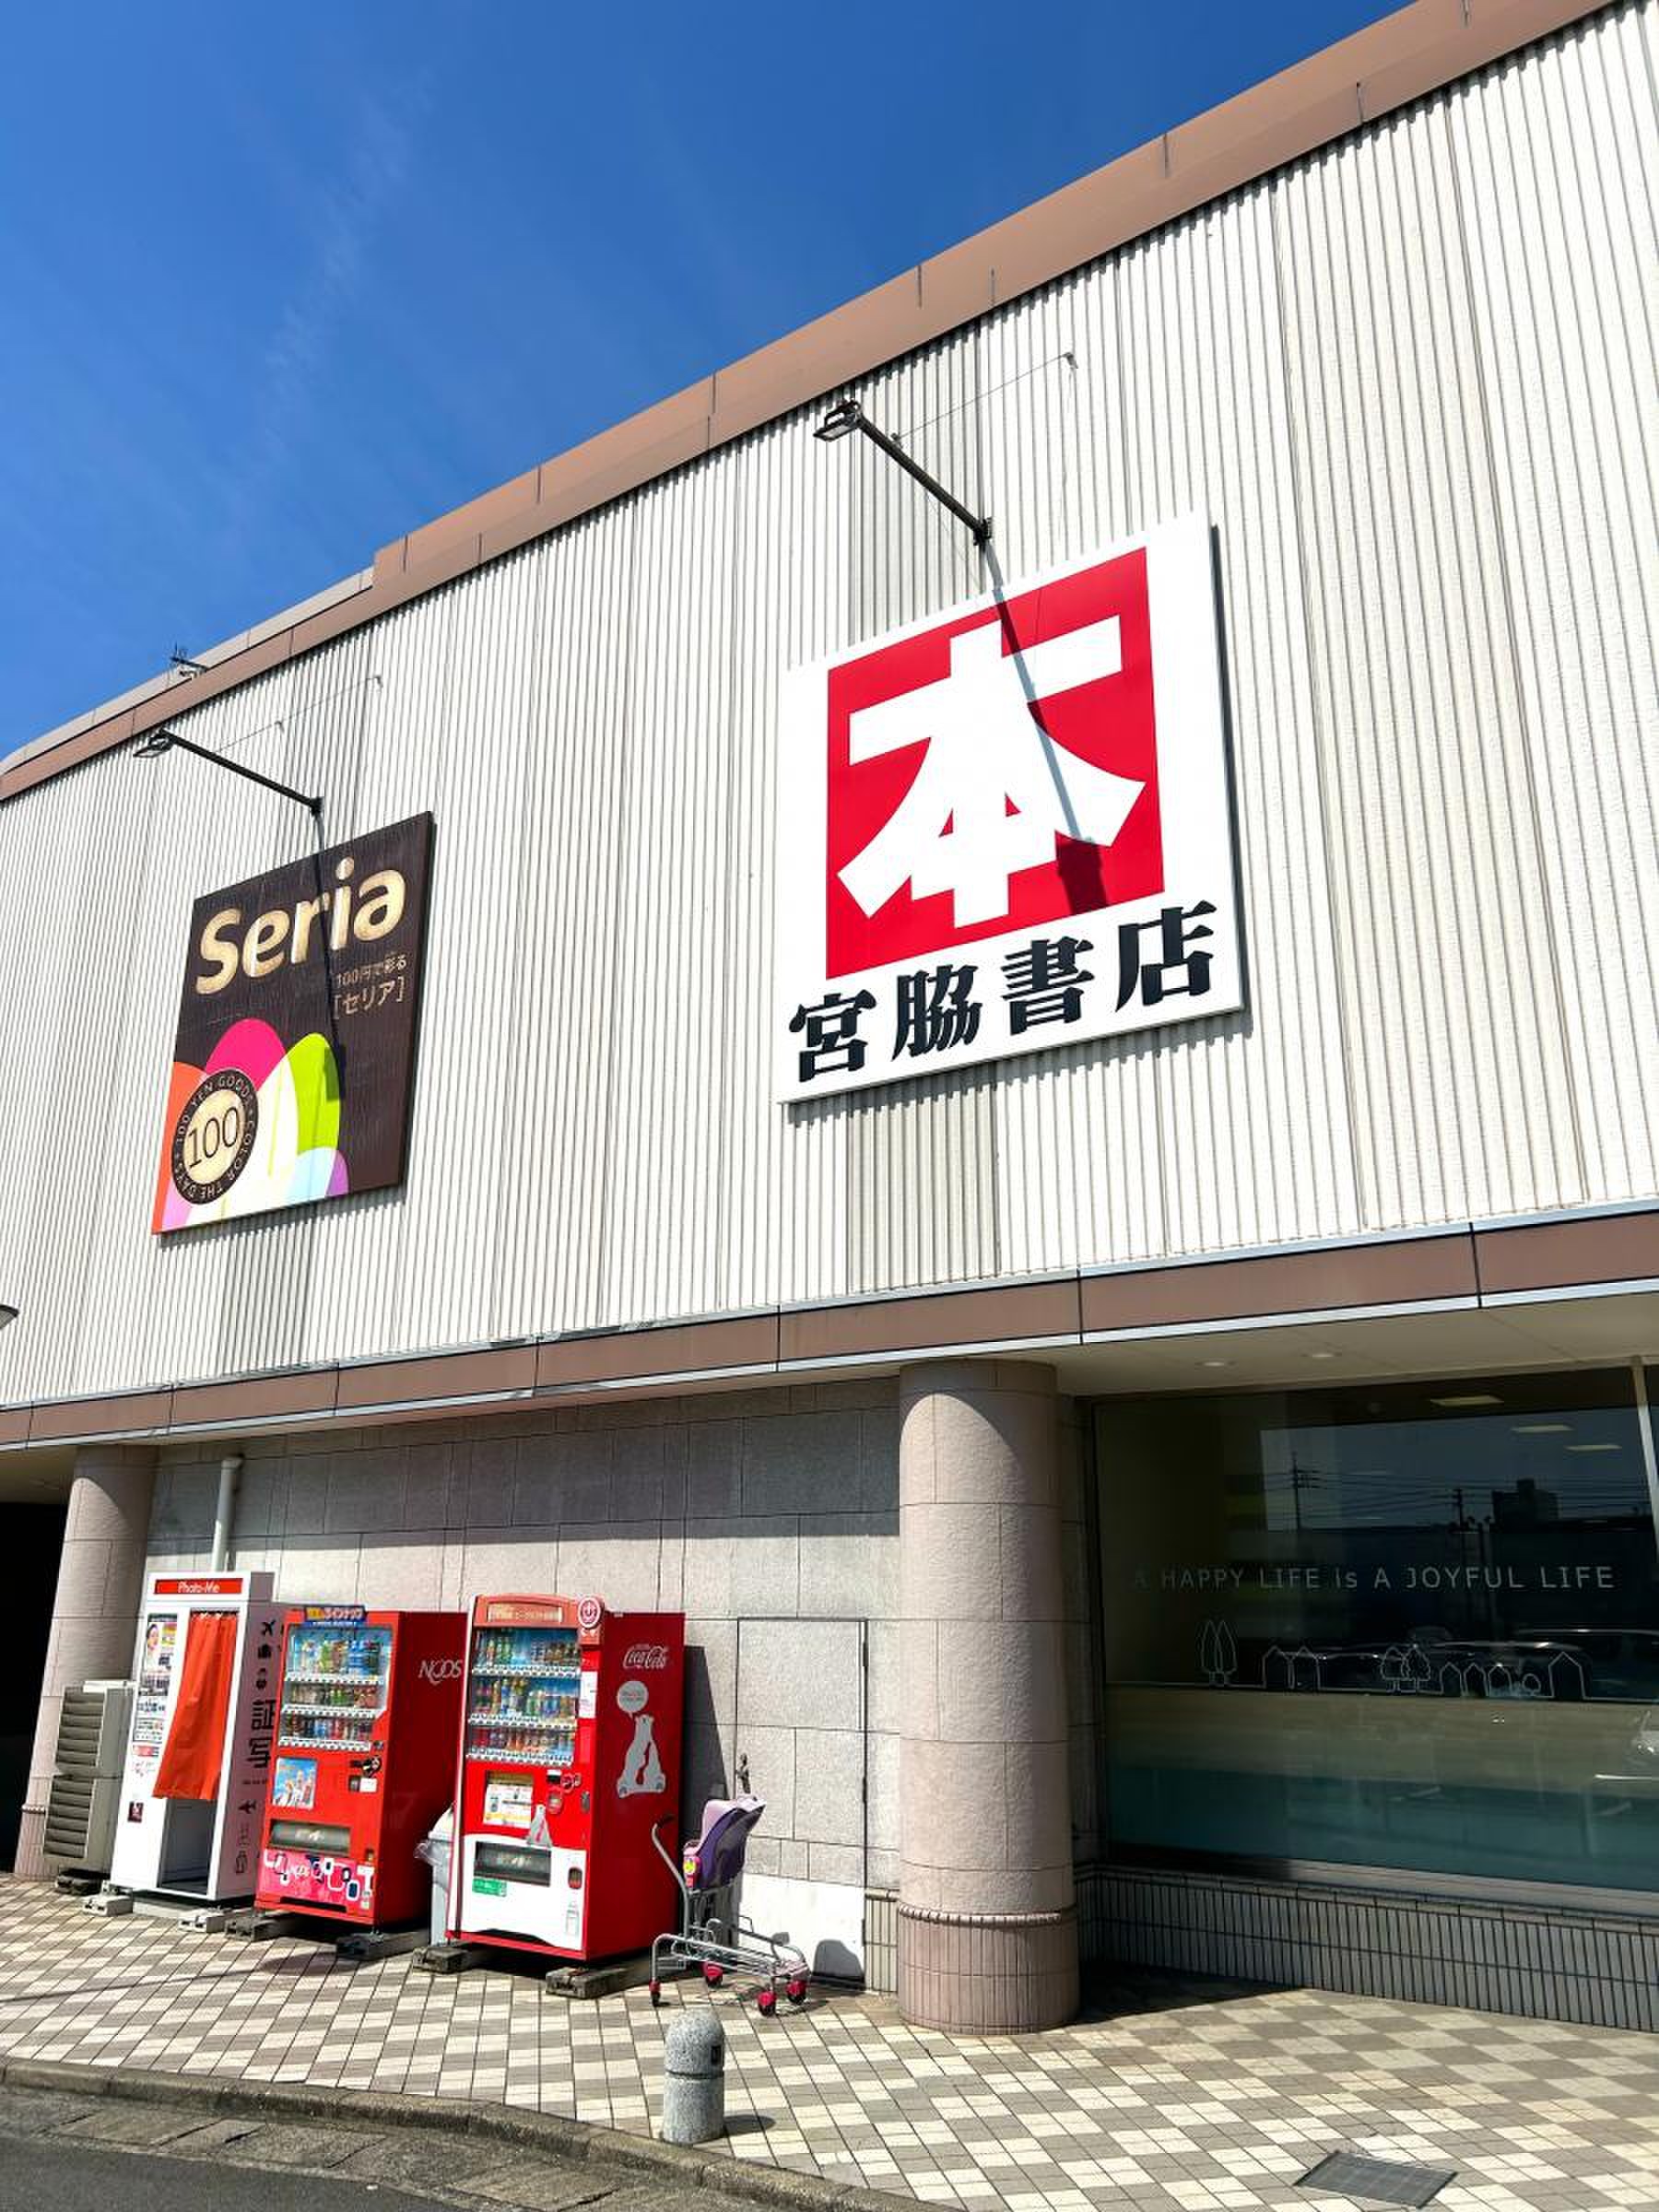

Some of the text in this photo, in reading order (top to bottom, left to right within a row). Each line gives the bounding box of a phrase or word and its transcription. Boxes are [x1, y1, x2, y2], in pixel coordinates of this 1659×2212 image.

[837, 614, 1147, 929] 本
[195, 856, 406, 995] Seria
[789, 900, 1217, 1083] 宮脇書店
[188, 1106, 241, 1169] 100
[1160, 1567, 1244, 1591] HAPPY
[1259, 1567, 1321, 1590] LIFE
[1373, 1566, 1392, 1590] A
[1406, 1566, 1526, 1590] JOYFUL
[1540, 1566, 1615, 1590] LIFE
